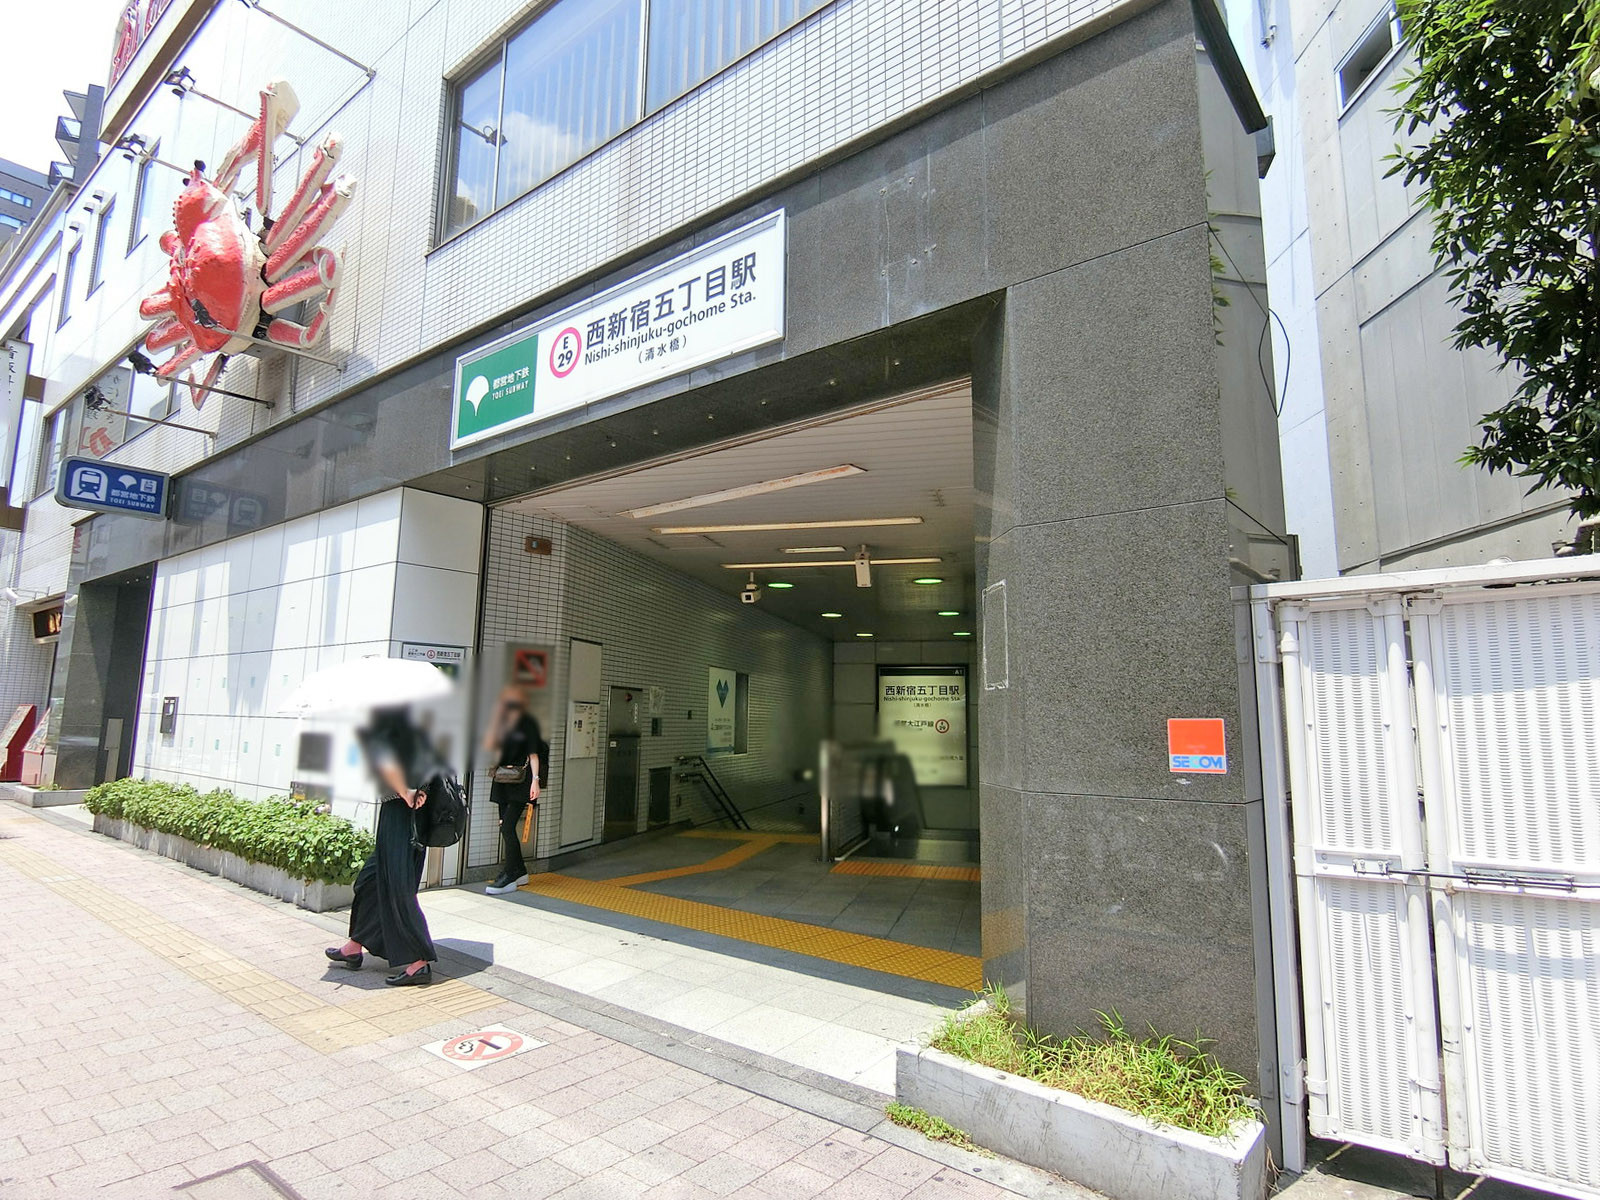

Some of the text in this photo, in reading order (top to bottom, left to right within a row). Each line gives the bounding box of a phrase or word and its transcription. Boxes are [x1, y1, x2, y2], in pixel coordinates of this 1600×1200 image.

[586, 252, 757, 350] 西新宿五丁目駅
[584, 291, 757, 365] Nishi-shinjuku-gochome Sta.
[563, 336, 569, 350] E
[557, 350, 573, 368] 29
[493, 366, 530, 390] 都営地下鉄
[492, 380, 529, 400] TOEI SUBWAY
[127, 501, 155, 509] SUBWAY
[885, 685, 960, 696] 西新宿五丁目駅
[1172, 755, 1223, 769] SECOM
